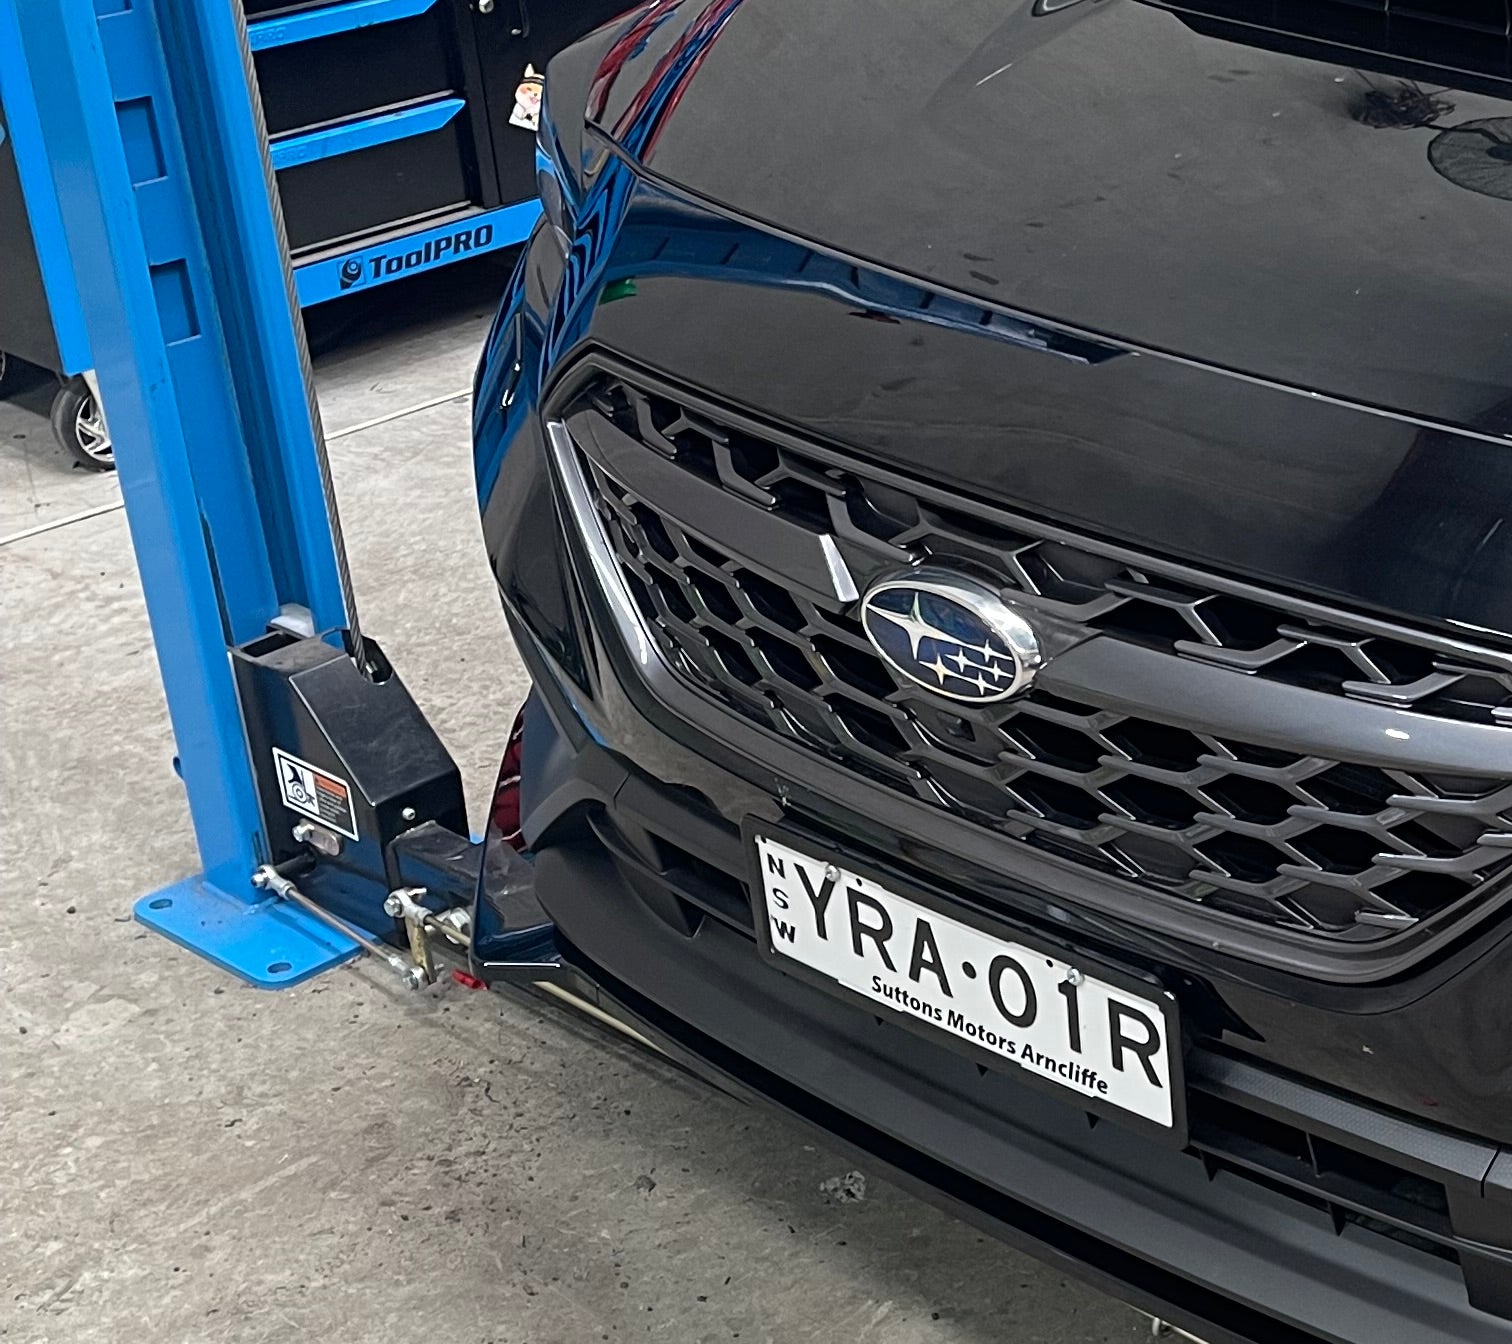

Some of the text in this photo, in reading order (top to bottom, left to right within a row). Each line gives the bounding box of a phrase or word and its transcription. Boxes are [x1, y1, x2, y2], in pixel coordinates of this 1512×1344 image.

[368, 224, 493, 280] ToolPRO
[871, 974, 1109, 1095] Suttons Motors Arncliffe
